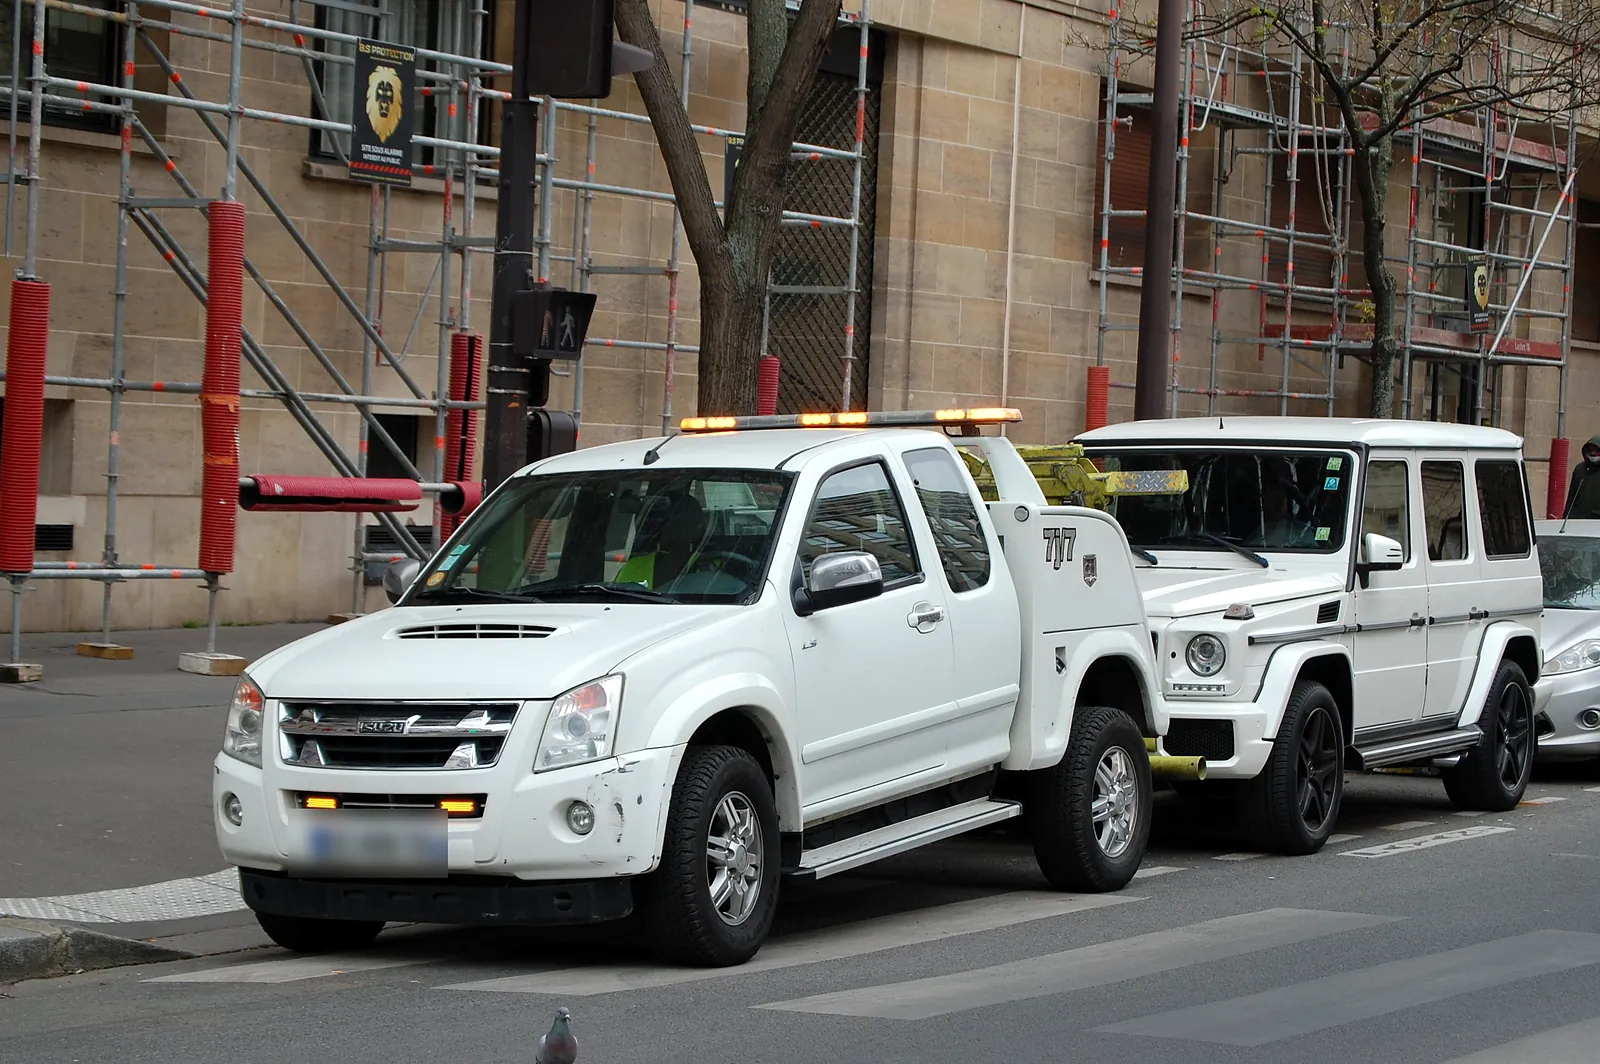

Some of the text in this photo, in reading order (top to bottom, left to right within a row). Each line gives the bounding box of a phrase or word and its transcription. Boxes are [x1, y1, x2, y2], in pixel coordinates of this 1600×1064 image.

[371, 46, 414, 62] PROTECTION
[361, 144, 403, 157] SITE SOUS ALARME
[360, 722, 404, 732] ISUZU
